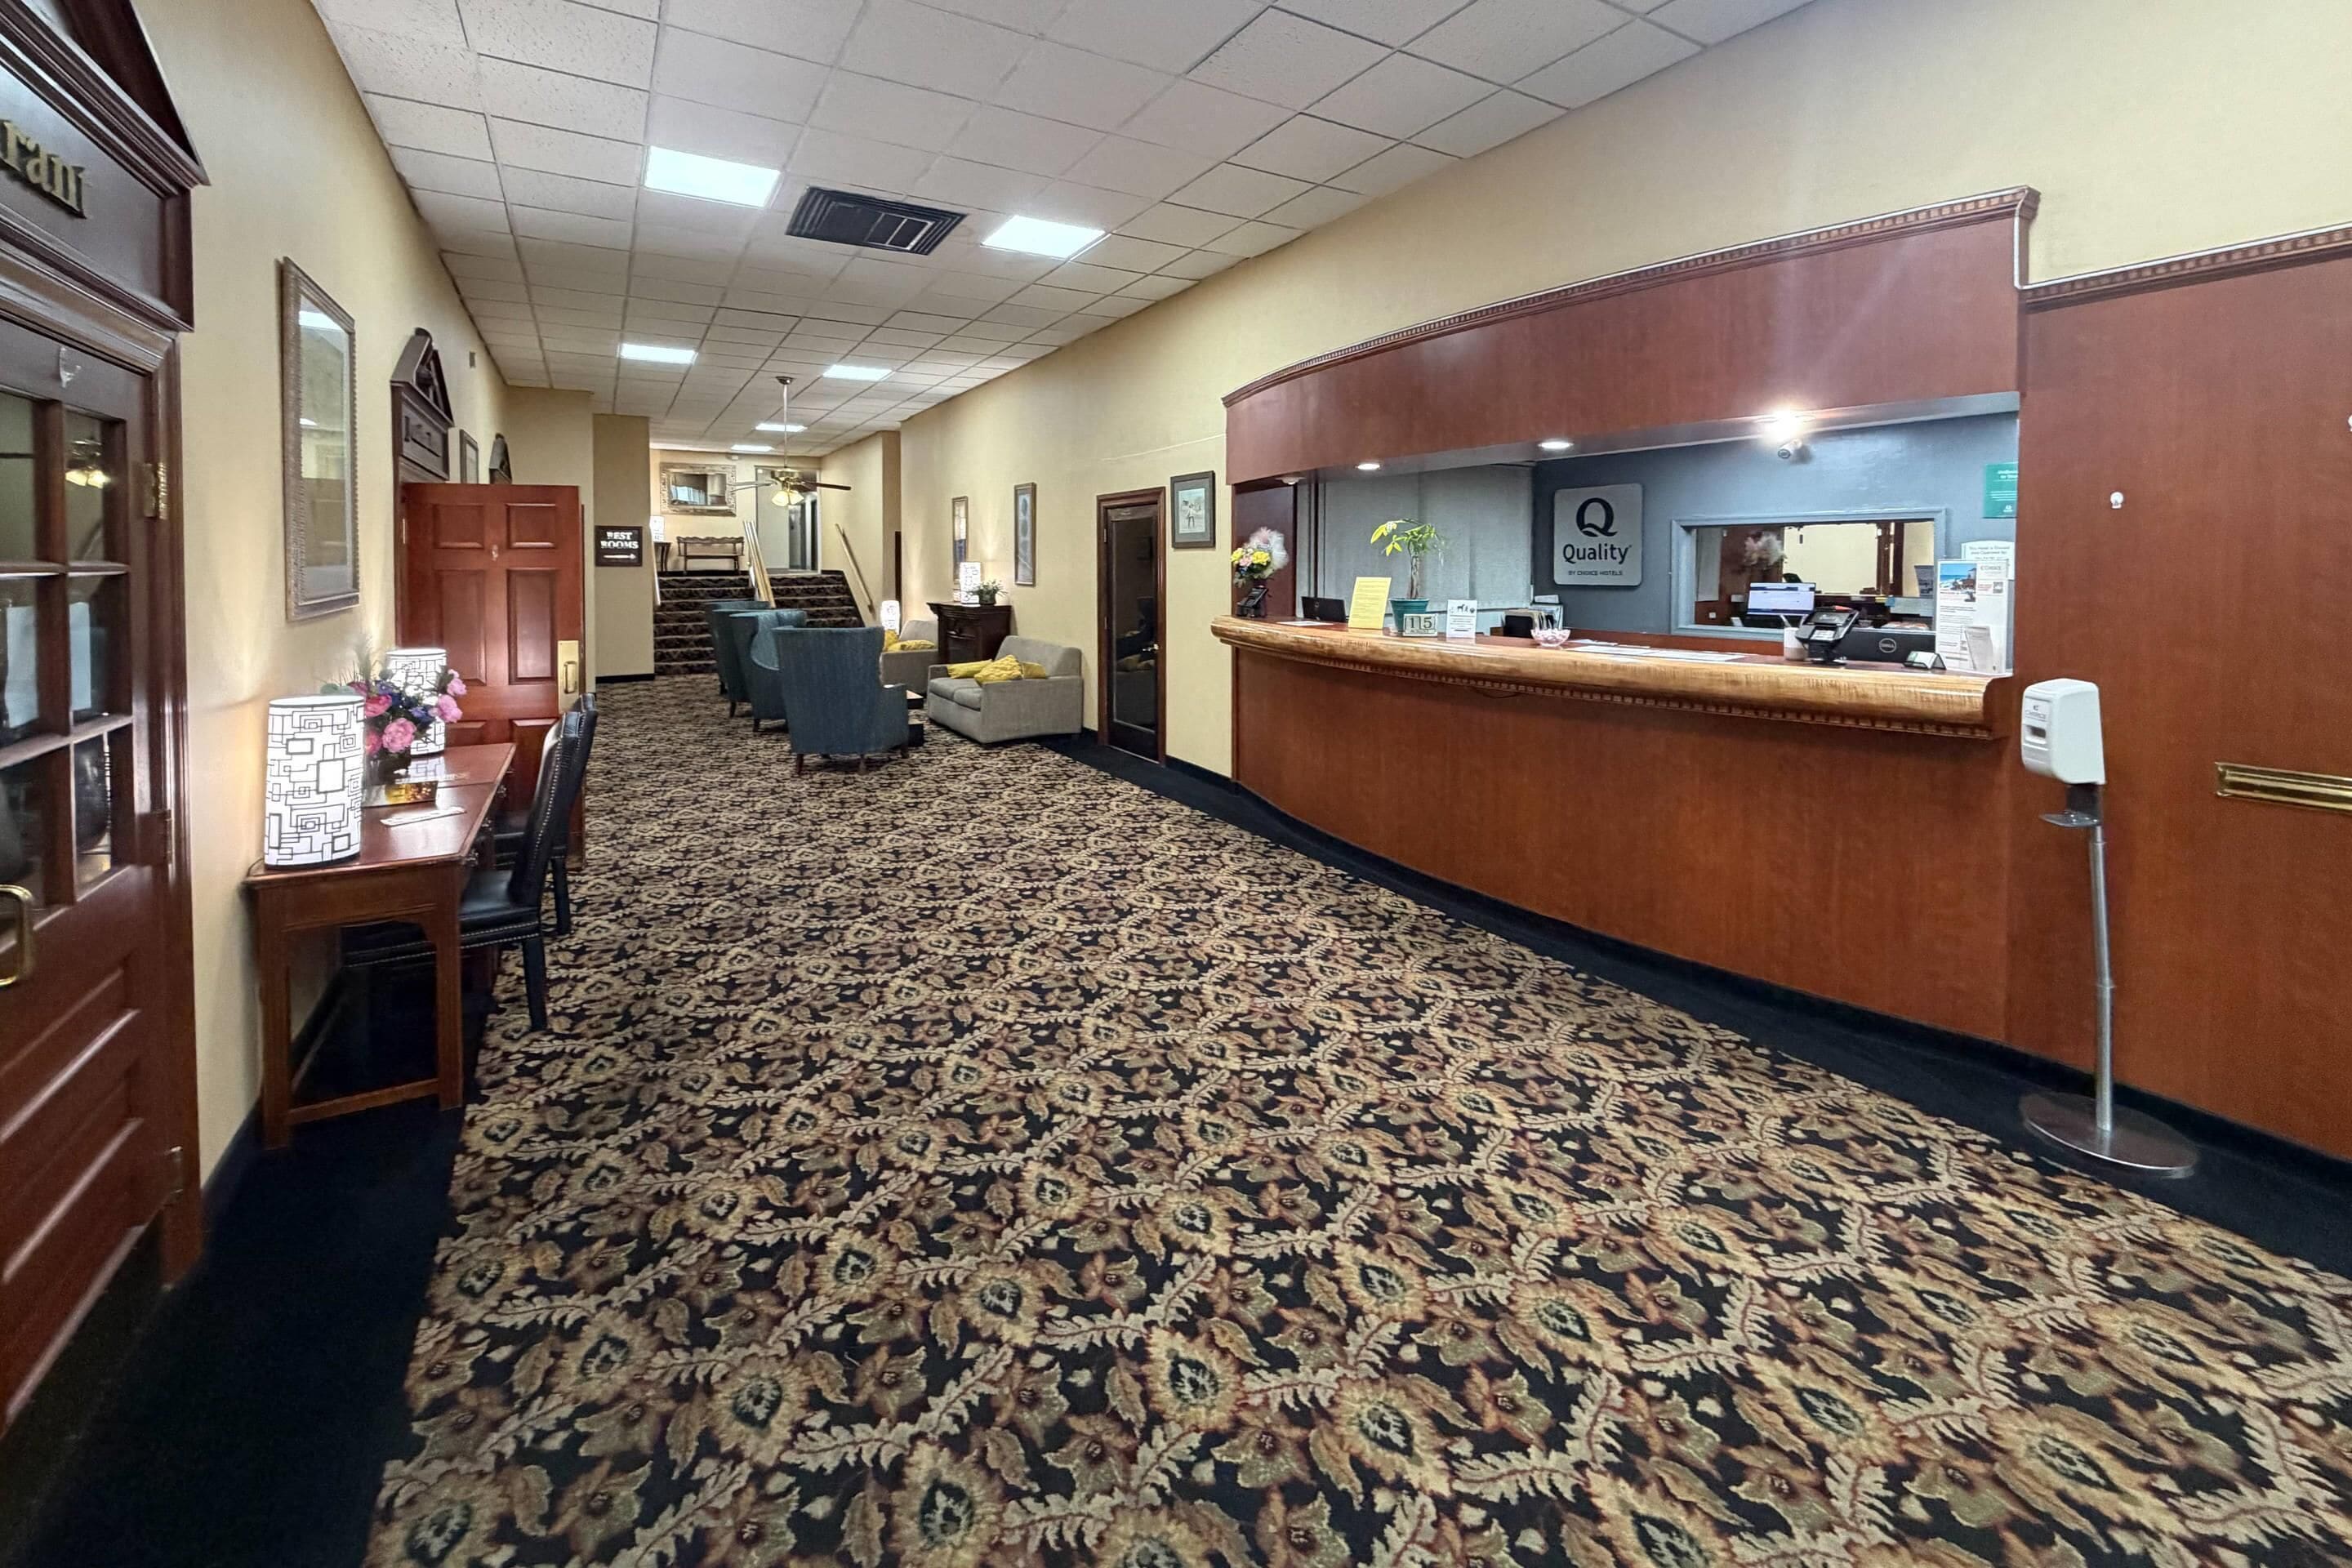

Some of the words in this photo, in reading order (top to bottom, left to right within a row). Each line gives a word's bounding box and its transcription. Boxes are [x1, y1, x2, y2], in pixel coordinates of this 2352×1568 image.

[1576, 497, 1618, 537] Q
[607, 532, 633, 540] REST
[600, 541, 639, 549] ROOMS
[1562, 543, 1629, 565] Quality
